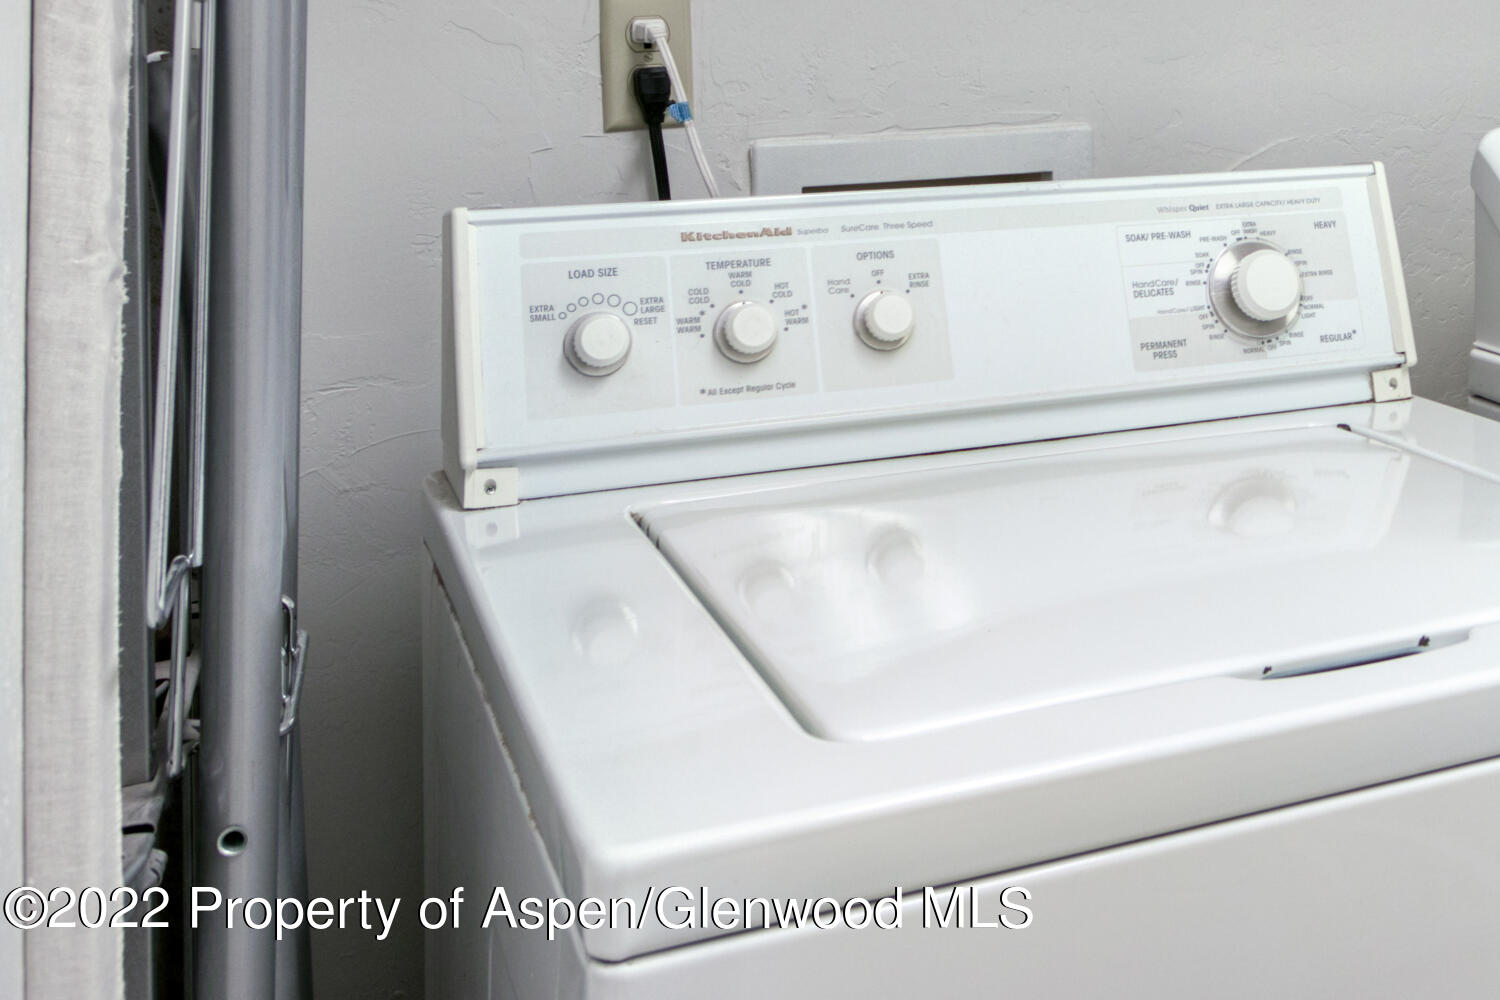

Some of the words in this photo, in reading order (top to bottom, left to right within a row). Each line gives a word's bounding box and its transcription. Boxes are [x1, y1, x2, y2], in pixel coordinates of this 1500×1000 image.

[1188, 204, 1209, 213] Quiet
[1313, 220, 1337, 229] HEAVY
[680, 226, 793, 243] KitchenAid
[882, 221, 905, 231] Three
[906, 219, 934, 230] Speed
[1125, 233, 1149, 242] SOAK/
[1150, 230, 1192, 241] PRE-WASH
[856, 250, 895, 261] OPTIONS
[705, 258, 772, 270] TEMPERATURE
[568, 268, 595, 280] LOAD
[597, 267, 619, 278] SIZE
[728, 271, 753, 279] WARM
[871, 269, 885, 277] OFF
[908, 272, 931, 280] EXTRA
[730, 279, 752, 288] COLD
[774, 282, 790, 290] HOT
[687, 287, 709, 296] COLD
[772, 290, 793, 299] COLD
[1133, 288, 1175, 298] DELICATES
[640, 296, 664, 305] EXTRA
[688, 296, 710, 304] COLD
[529, 304, 555, 313] EXTRA
[640, 304, 665, 314] LARGE
[784, 309, 800, 317] HOT
[529, 314, 557, 323] SMALL
[633, 316, 658, 326] RESET
[675, 316, 701, 325] WARM
[785, 317, 809, 326] WARM
[676, 325, 702, 334] WARM
[1320, 332, 1353, 343] REGULAR
[1140, 338, 1187, 351] PERMANENT
[1153, 350, 1178, 360] PRESS
[719, 386, 744, 396] Except
